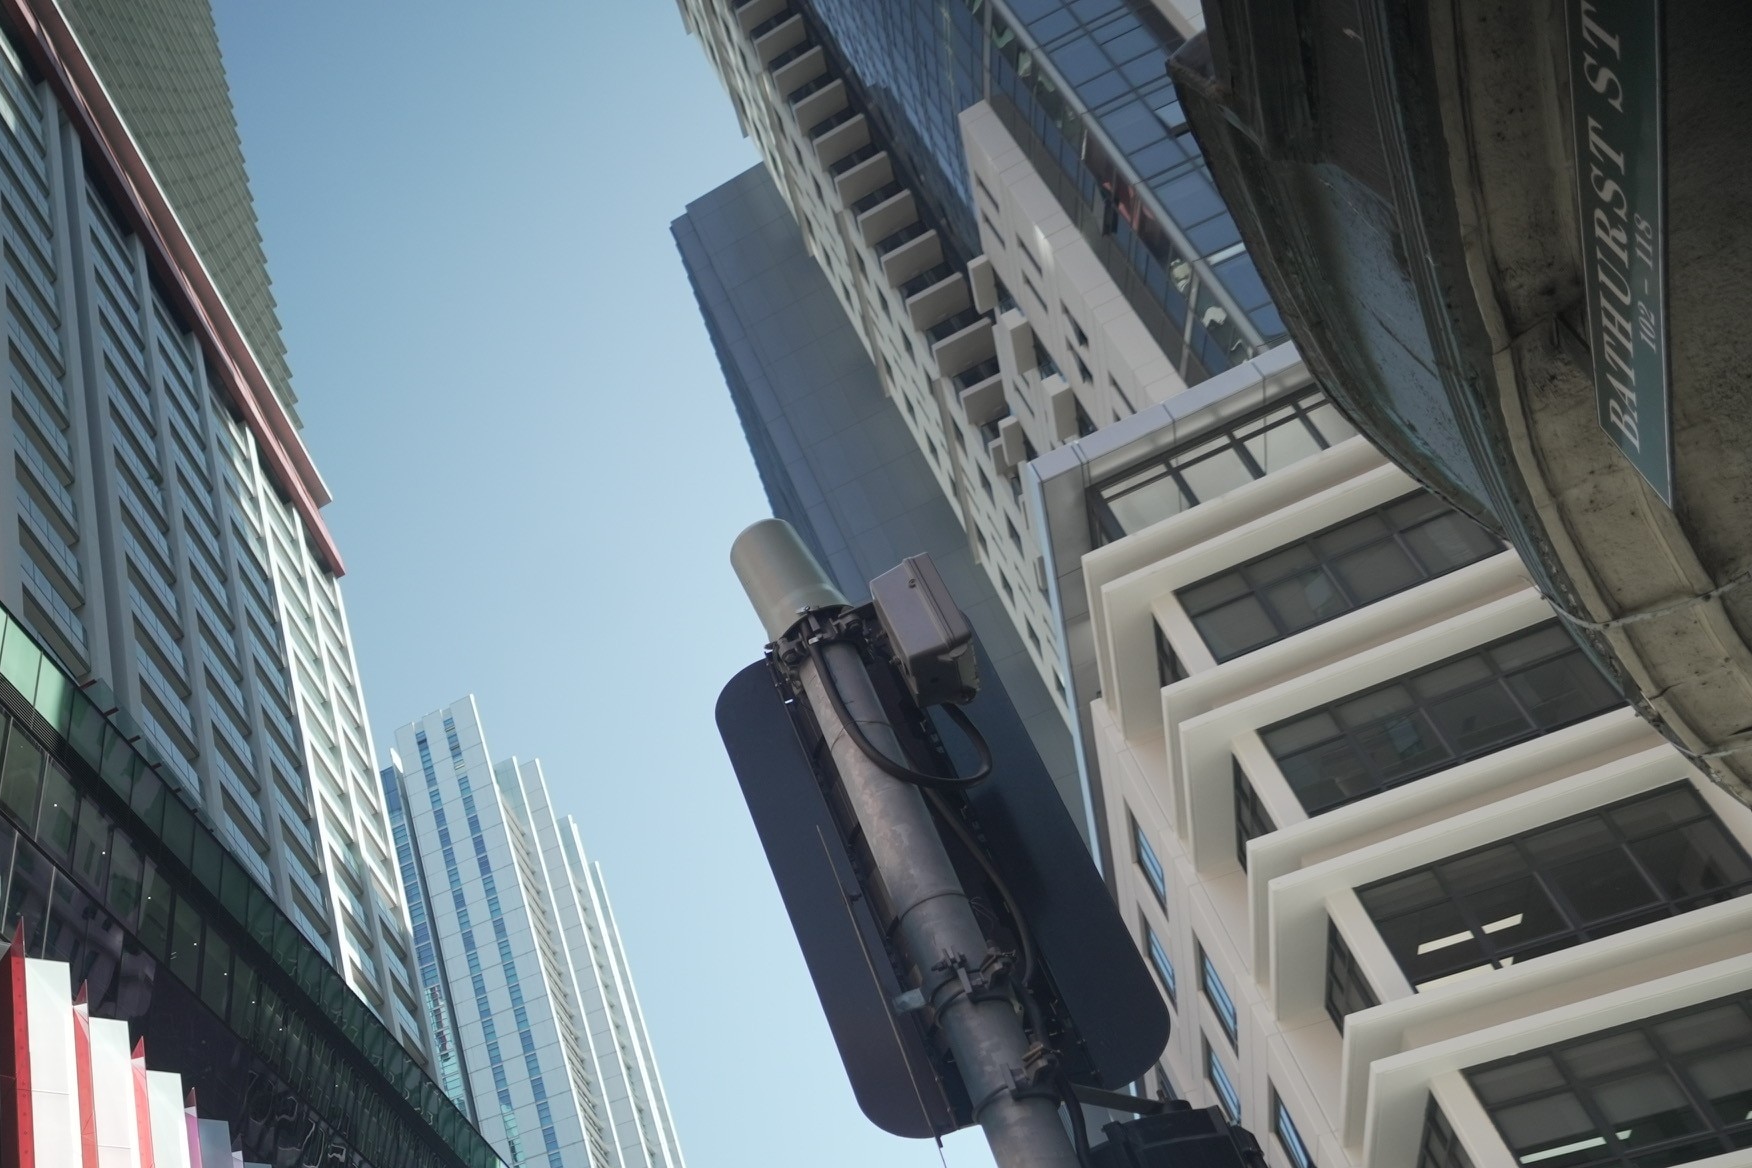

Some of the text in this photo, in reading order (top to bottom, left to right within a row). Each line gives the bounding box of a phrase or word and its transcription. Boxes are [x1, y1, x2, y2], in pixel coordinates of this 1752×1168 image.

[1581, 0, 1640, 454] BATHURST ST
[1634, 213, 1653, 269] 118
[1639, 301, 1657, 353] 102
